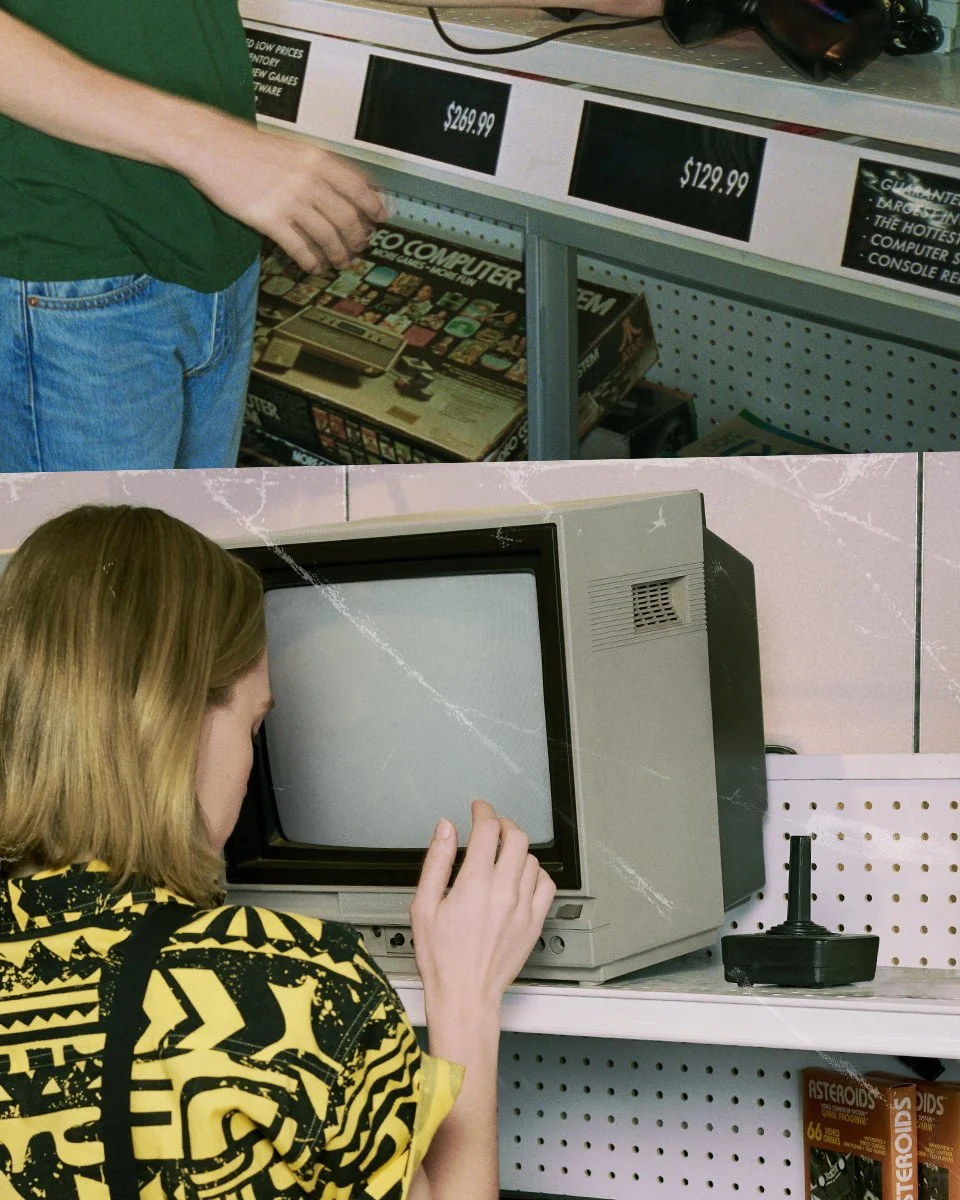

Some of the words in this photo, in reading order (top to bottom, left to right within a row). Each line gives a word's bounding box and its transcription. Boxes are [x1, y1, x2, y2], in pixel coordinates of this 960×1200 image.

[255, 41, 275, 52] LOW
[275, 45, 305, 59] PRICES
[268, 71, 299, 87] GAMES
[443, 101, 496, 139] $269.99
[680, 156, 749, 199] $129.99
[873, 215, 900, 231] THE
[870, 233, 950, 262] COMPUTER
[371, 248, 399, 262] MORE
[457, 274, 478, 288] FUN
[402, 240, 522, 290] COMPUTER
[868, 252, 938, 279] CONSOLE
[808, 1079, 876, 1111] ASTEROIDS
[806, 1121, 823, 1142] 66
[824, 1127, 840, 1137] VIDEO
[823, 1135, 841, 1146] GAMES
